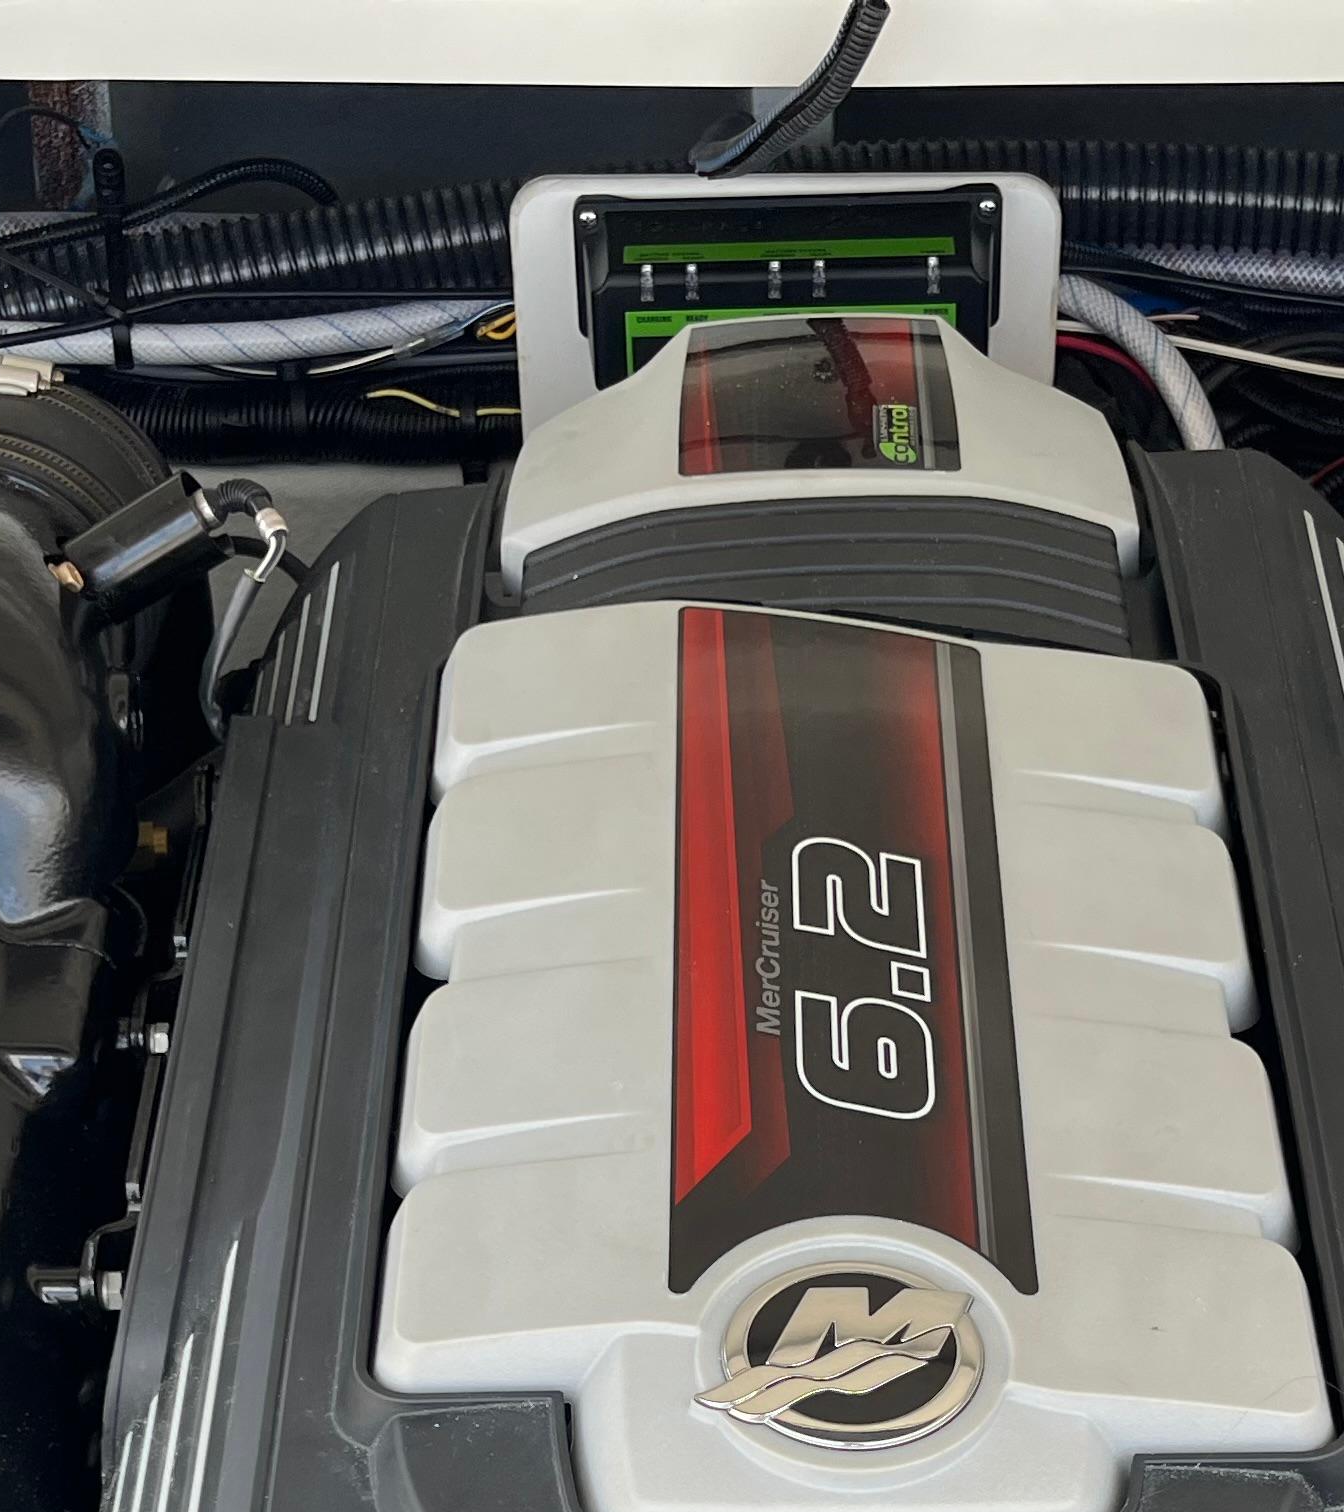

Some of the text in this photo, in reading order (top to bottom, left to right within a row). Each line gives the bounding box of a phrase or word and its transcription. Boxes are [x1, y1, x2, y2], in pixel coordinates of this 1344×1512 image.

[888, 405, 909, 463] control
[756, 878, 780, 1037] MerCruiser
[792, 836, 936, 1121] 6.2
